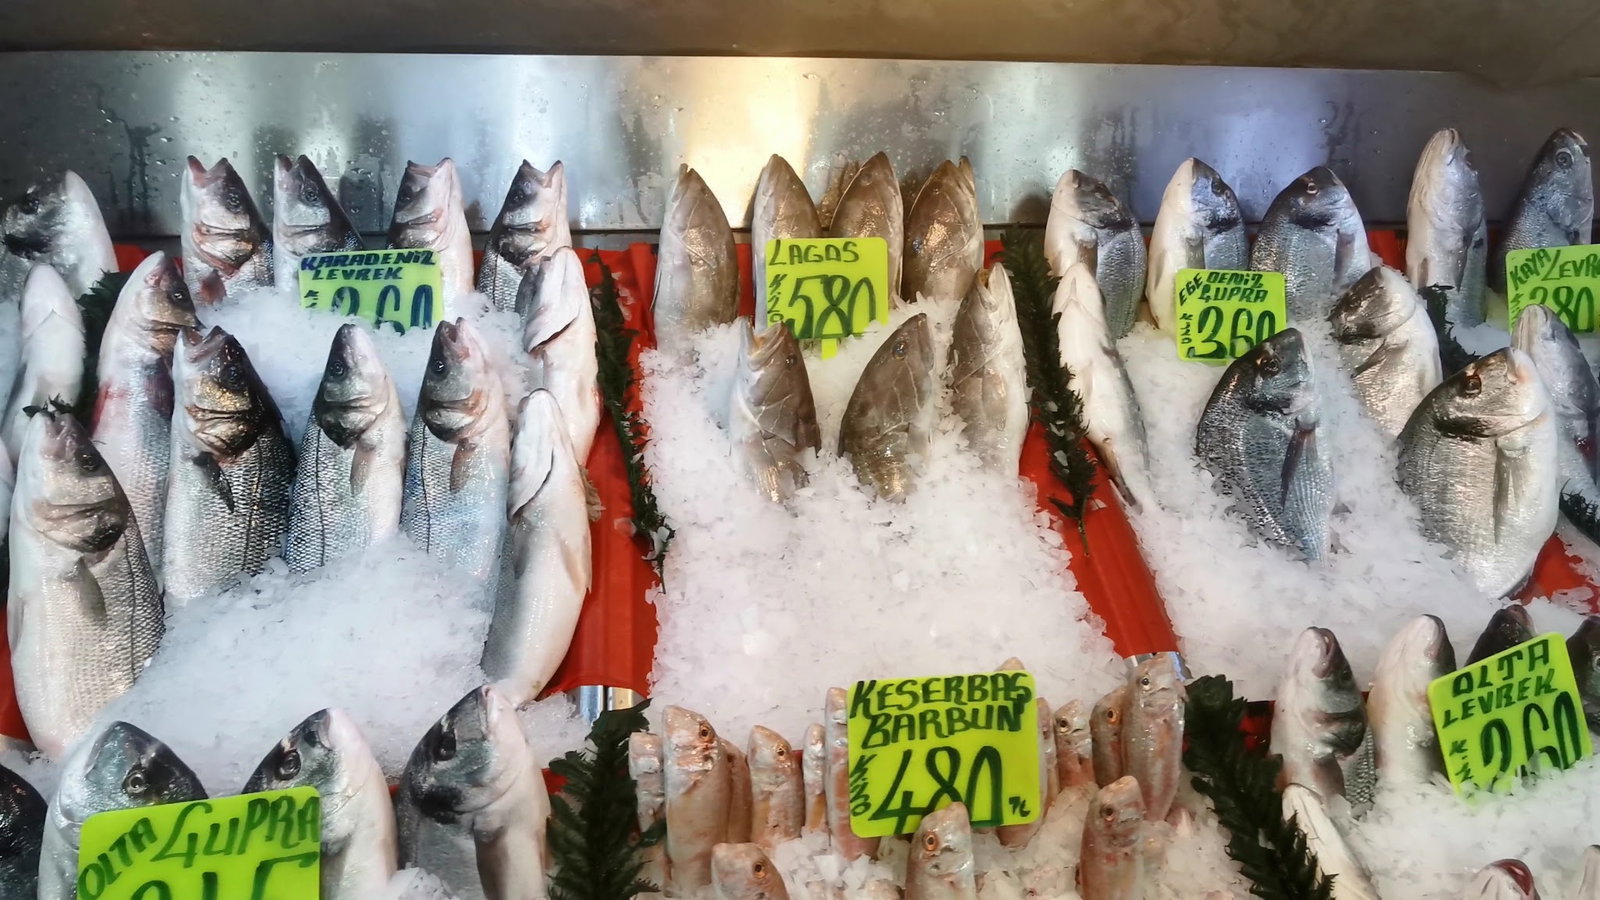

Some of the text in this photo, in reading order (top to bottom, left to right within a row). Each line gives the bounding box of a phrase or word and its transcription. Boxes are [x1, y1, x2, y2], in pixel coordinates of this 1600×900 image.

[312, 267, 403, 281] LEVREK
[769, 239, 859, 266] LAGOS
[1510, 248, 1600, 291] KAYA LEVR
[784, 274, 877, 339] 580
[1179, 272, 1203, 306] EGE
[1186, 305, 1276, 359] 360
[1452, 639, 1550, 698] OLTA
[861, 694, 1025, 749] BARBUN
[1442, 668, 1558, 729] LEVREK
[868, 745, 1004, 835] 480
[78, 817, 157, 900] OLTA
